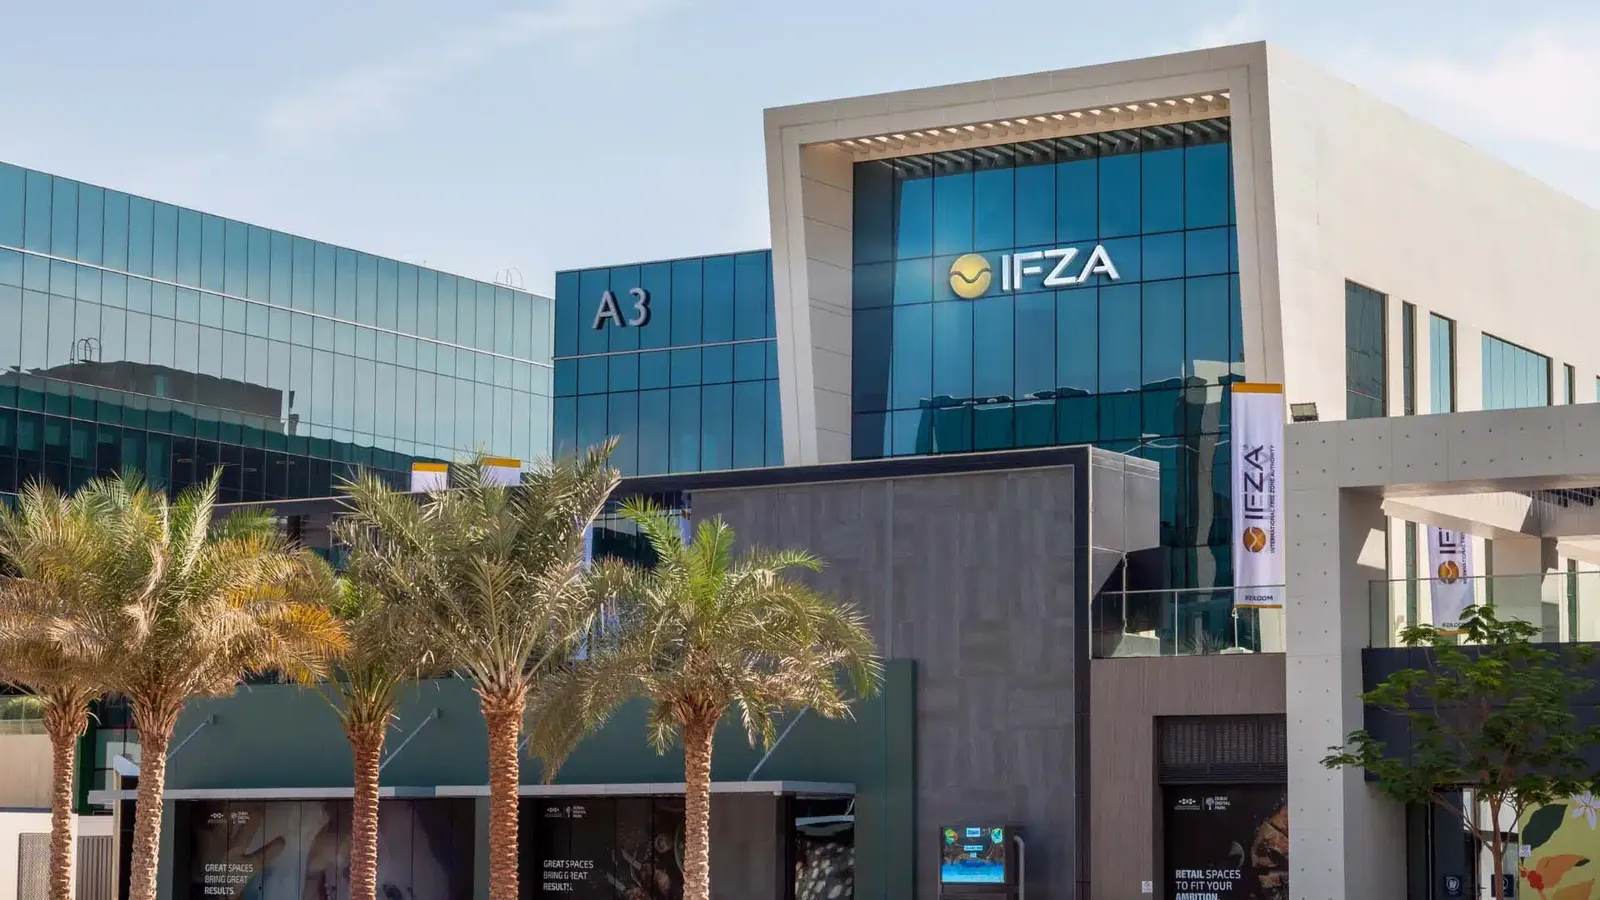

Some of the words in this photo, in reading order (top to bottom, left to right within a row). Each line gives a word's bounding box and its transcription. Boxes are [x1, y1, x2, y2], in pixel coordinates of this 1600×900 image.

[1001, 244, 1121, 292] IFZA
[1243, 445, 1264, 520] IFZA
[1438, 527, 1457, 555] IF
[205, 863, 227, 872] GREAT
[228, 863, 254, 873] SPACES
[544, 859, 565, 868] GREAT
[565, 860, 594, 869] SPACES
[543, 871, 563, 880] BRING
[563, 871, 589, 880] GREAT
[1175, 869, 1205, 879] RETAIL
[1205, 869, 1241, 879] SPACES
[204, 875, 226, 883] BRING
[226, 875, 249, 884] GREAT
[1175, 881, 1188, 891] TO
[1190, 881, 1205, 890] FIT
[1206, 881, 1233, 891] YOUR
